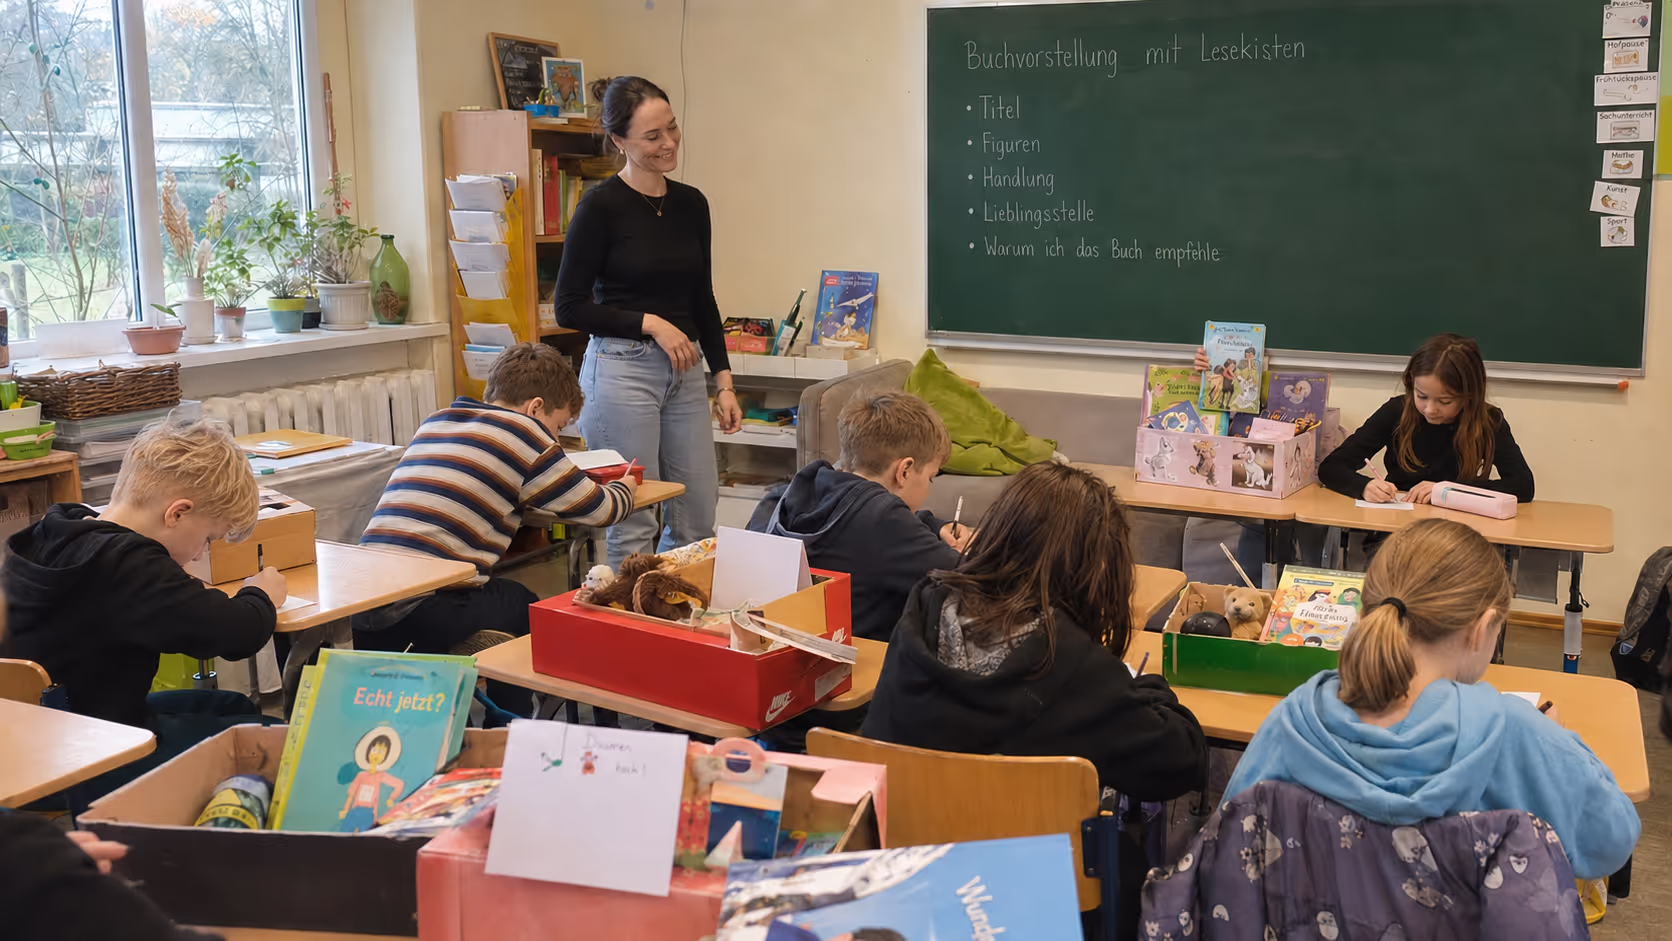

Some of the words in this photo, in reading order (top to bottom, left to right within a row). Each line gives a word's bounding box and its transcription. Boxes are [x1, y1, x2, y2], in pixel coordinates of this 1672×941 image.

[964, 38, 1118, 78] Buchvorstellung
[1145, 33, 1183, 65] mit
[1201, 32, 1305, 62] Lesekisten
[979, 94, 1020, 119] Titel
[1599, 112, 1653, 120] Sachunterricht
[982, 131, 1041, 161] Figuren
[983, 166, 1055, 195] Handlung
[1606, 185, 1628, 194] Kunst
[984, 199, 1095, 229] Lieblingsstelle
[984, 236, 1035, 257] Warum
[1045, 235, 1065, 257] ich
[1076, 236, 1100, 258] das
[1111, 237, 1143, 260] Buch
[1155, 240, 1221, 267] empfehle
[353, 686, 394, 708] Echt
[394, 691, 446, 713] jetzt?
